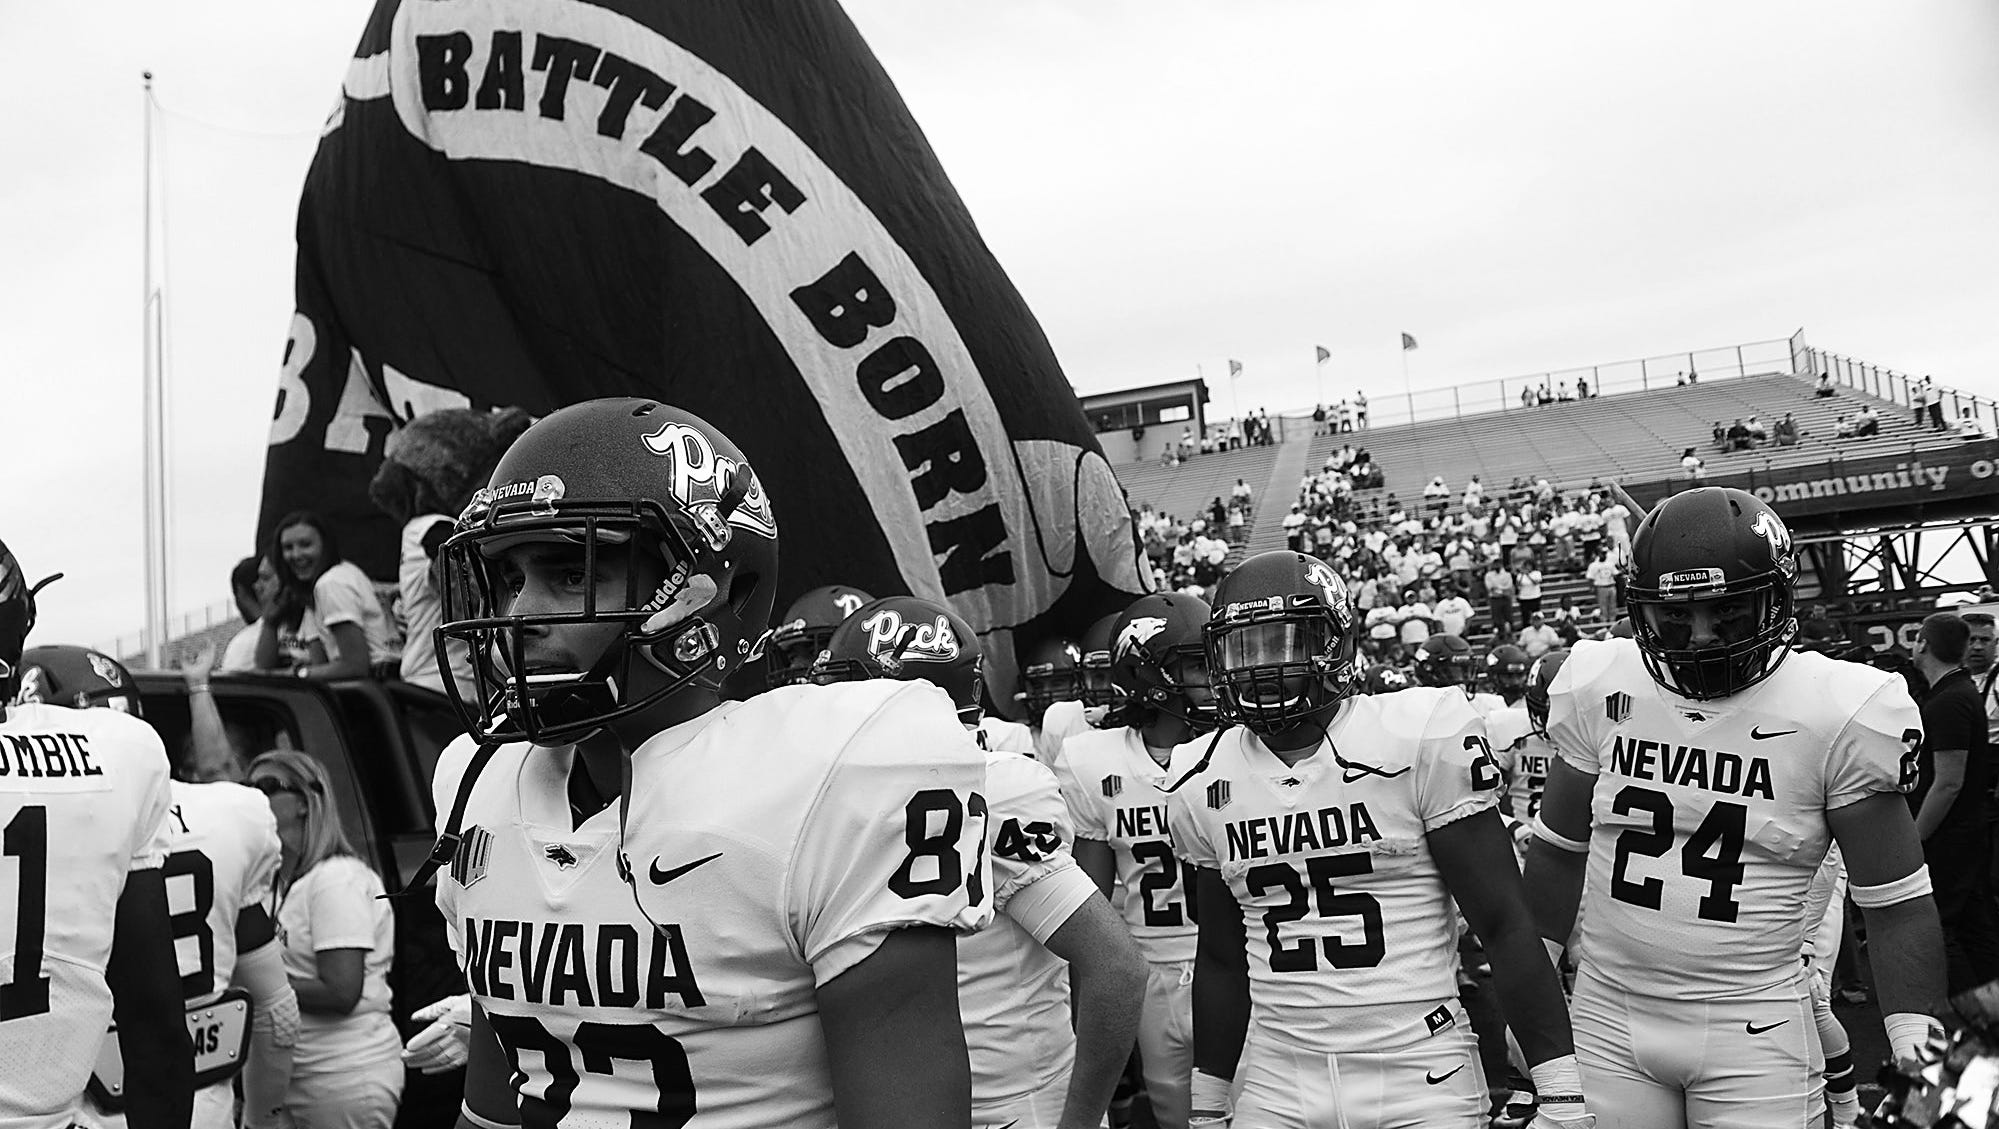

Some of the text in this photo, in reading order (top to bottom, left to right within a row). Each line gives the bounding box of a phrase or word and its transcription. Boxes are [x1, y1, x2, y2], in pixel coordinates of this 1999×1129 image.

[416, 30, 1015, 593] BATTLE BORN
[492, 482, 535, 500] NEVADA
[1748, 461, 1949, 503] ommunity
[1673, 572, 1708, 582] NEVADA
[1238, 600, 1269, 611] NEVADA
[1611, 736, 1775, 800] NEVADA
[1116, 804, 1176, 848] NEV
[1225, 802, 1383, 862] NEVADA
[1611, 785, 1748, 923] 24
[1246, 852, 1386, 973] 25
[464, 918, 707, 1009] NEVADA
[1432, 1012, 1445, 1025] M
